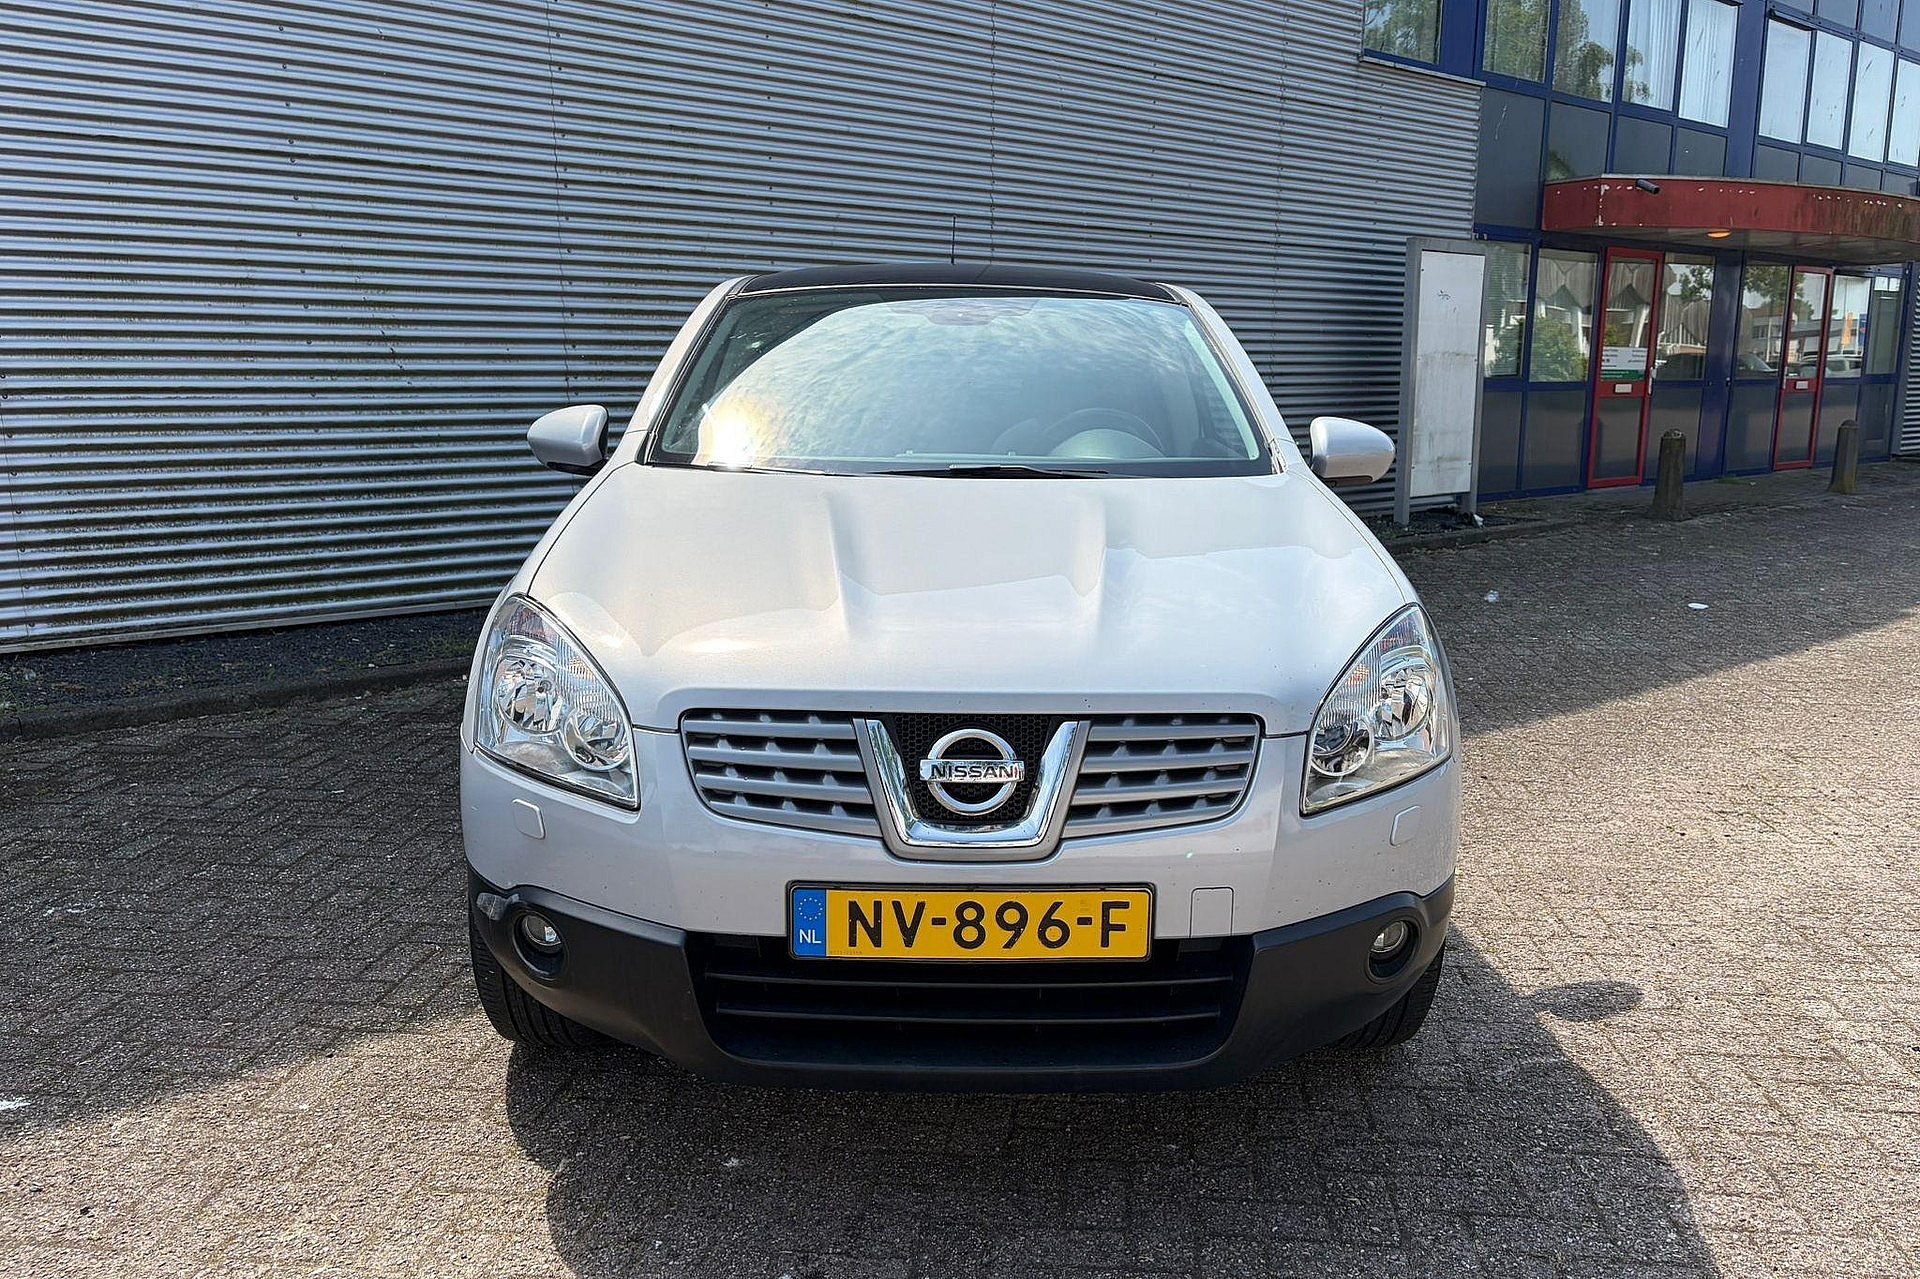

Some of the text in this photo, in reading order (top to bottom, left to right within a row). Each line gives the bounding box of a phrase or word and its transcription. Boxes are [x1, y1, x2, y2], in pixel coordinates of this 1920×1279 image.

[930, 764, 1014, 779] NISSAN
[848, 900, 1130, 949] NV-896-F
[799, 929, 822, 944] NL
